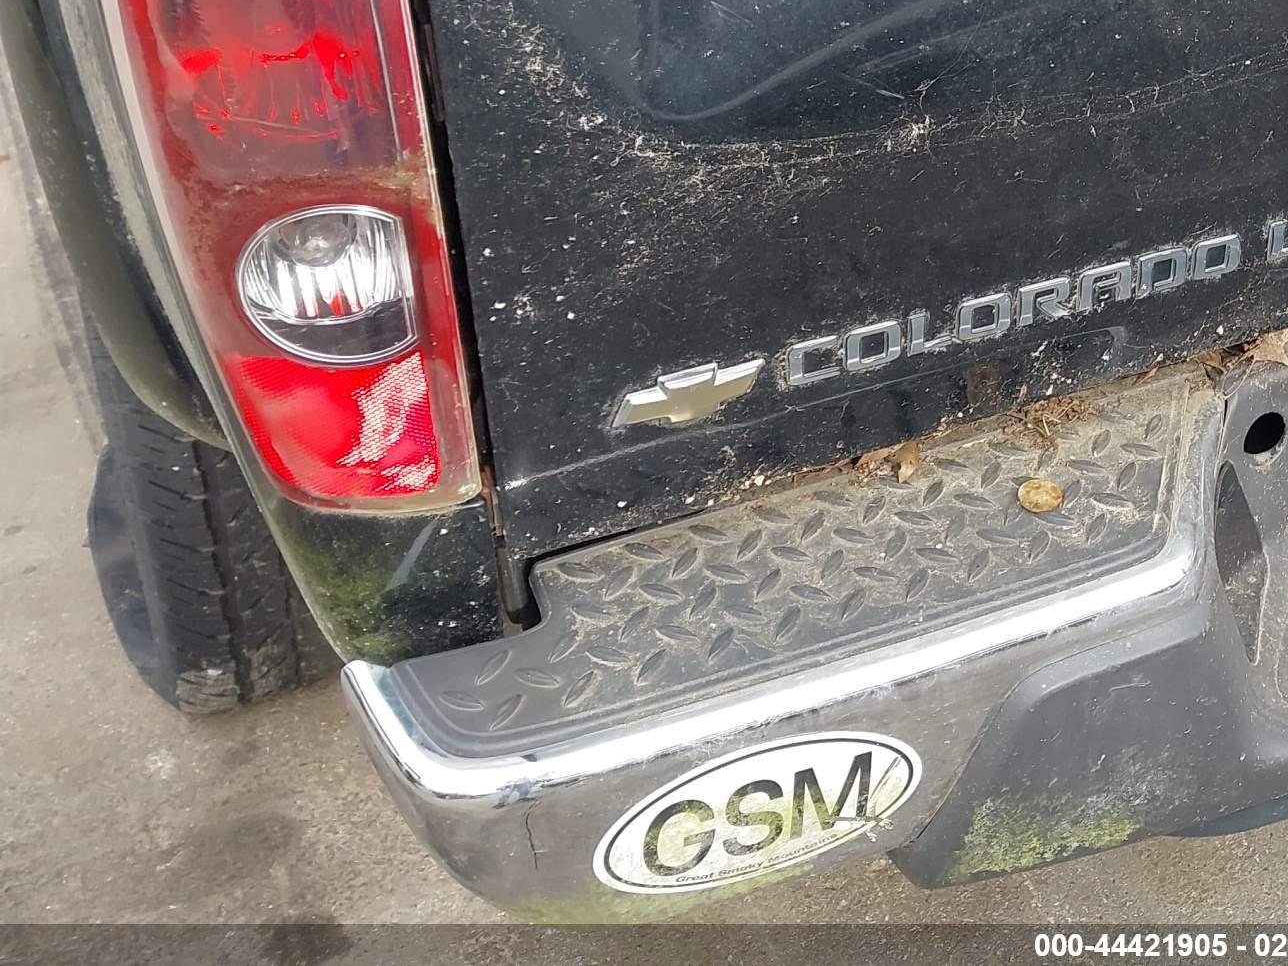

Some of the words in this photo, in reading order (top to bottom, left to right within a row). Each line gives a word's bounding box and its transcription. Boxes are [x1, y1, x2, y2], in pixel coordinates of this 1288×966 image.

[785, 233, 1242, 387] COLORADO
[643, 751, 872, 876] GSM
[675, 872, 715, 883] Great
